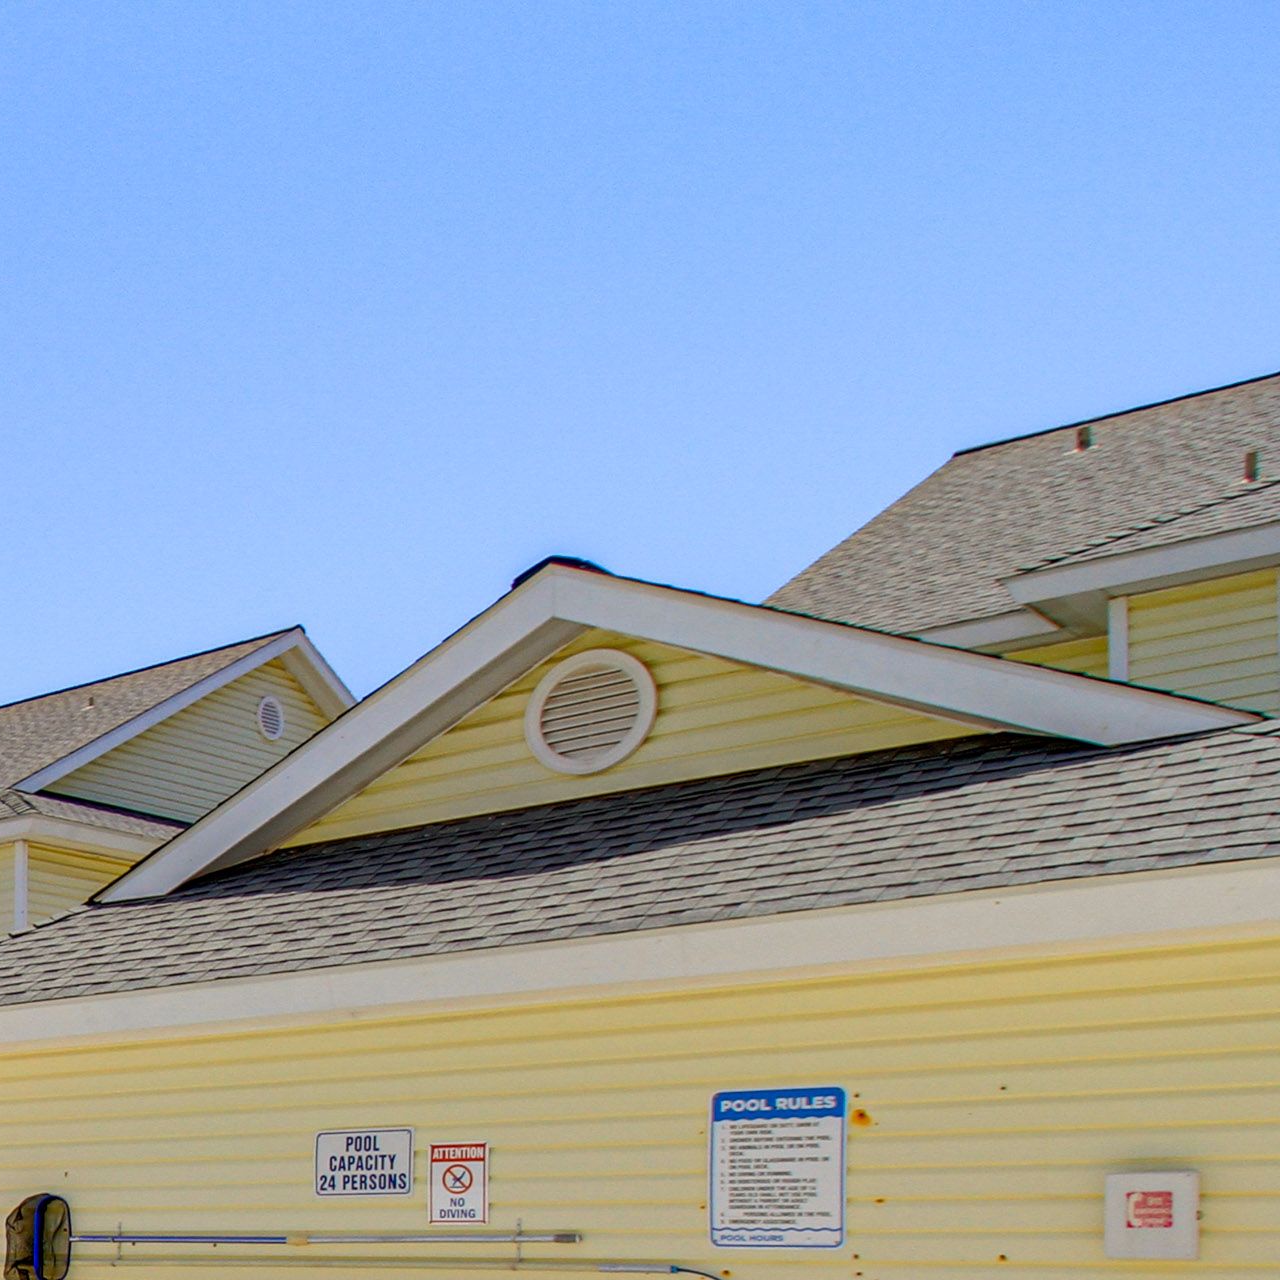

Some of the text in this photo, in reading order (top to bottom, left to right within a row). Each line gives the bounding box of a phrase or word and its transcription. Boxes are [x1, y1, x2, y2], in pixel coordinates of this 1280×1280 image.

[721, 1096, 837, 1112] POOL RULES
[346, 1135, 379, 1152] POOL
[432, 1146, 484, 1160] ATTENTION
[330, 1154, 396, 1171] CAPACITY
[320, 1173, 407, 1191] 24 PERSONS
[450, 1198, 465, 1207] NO
[440, 1209, 476, 1219] DIVING
